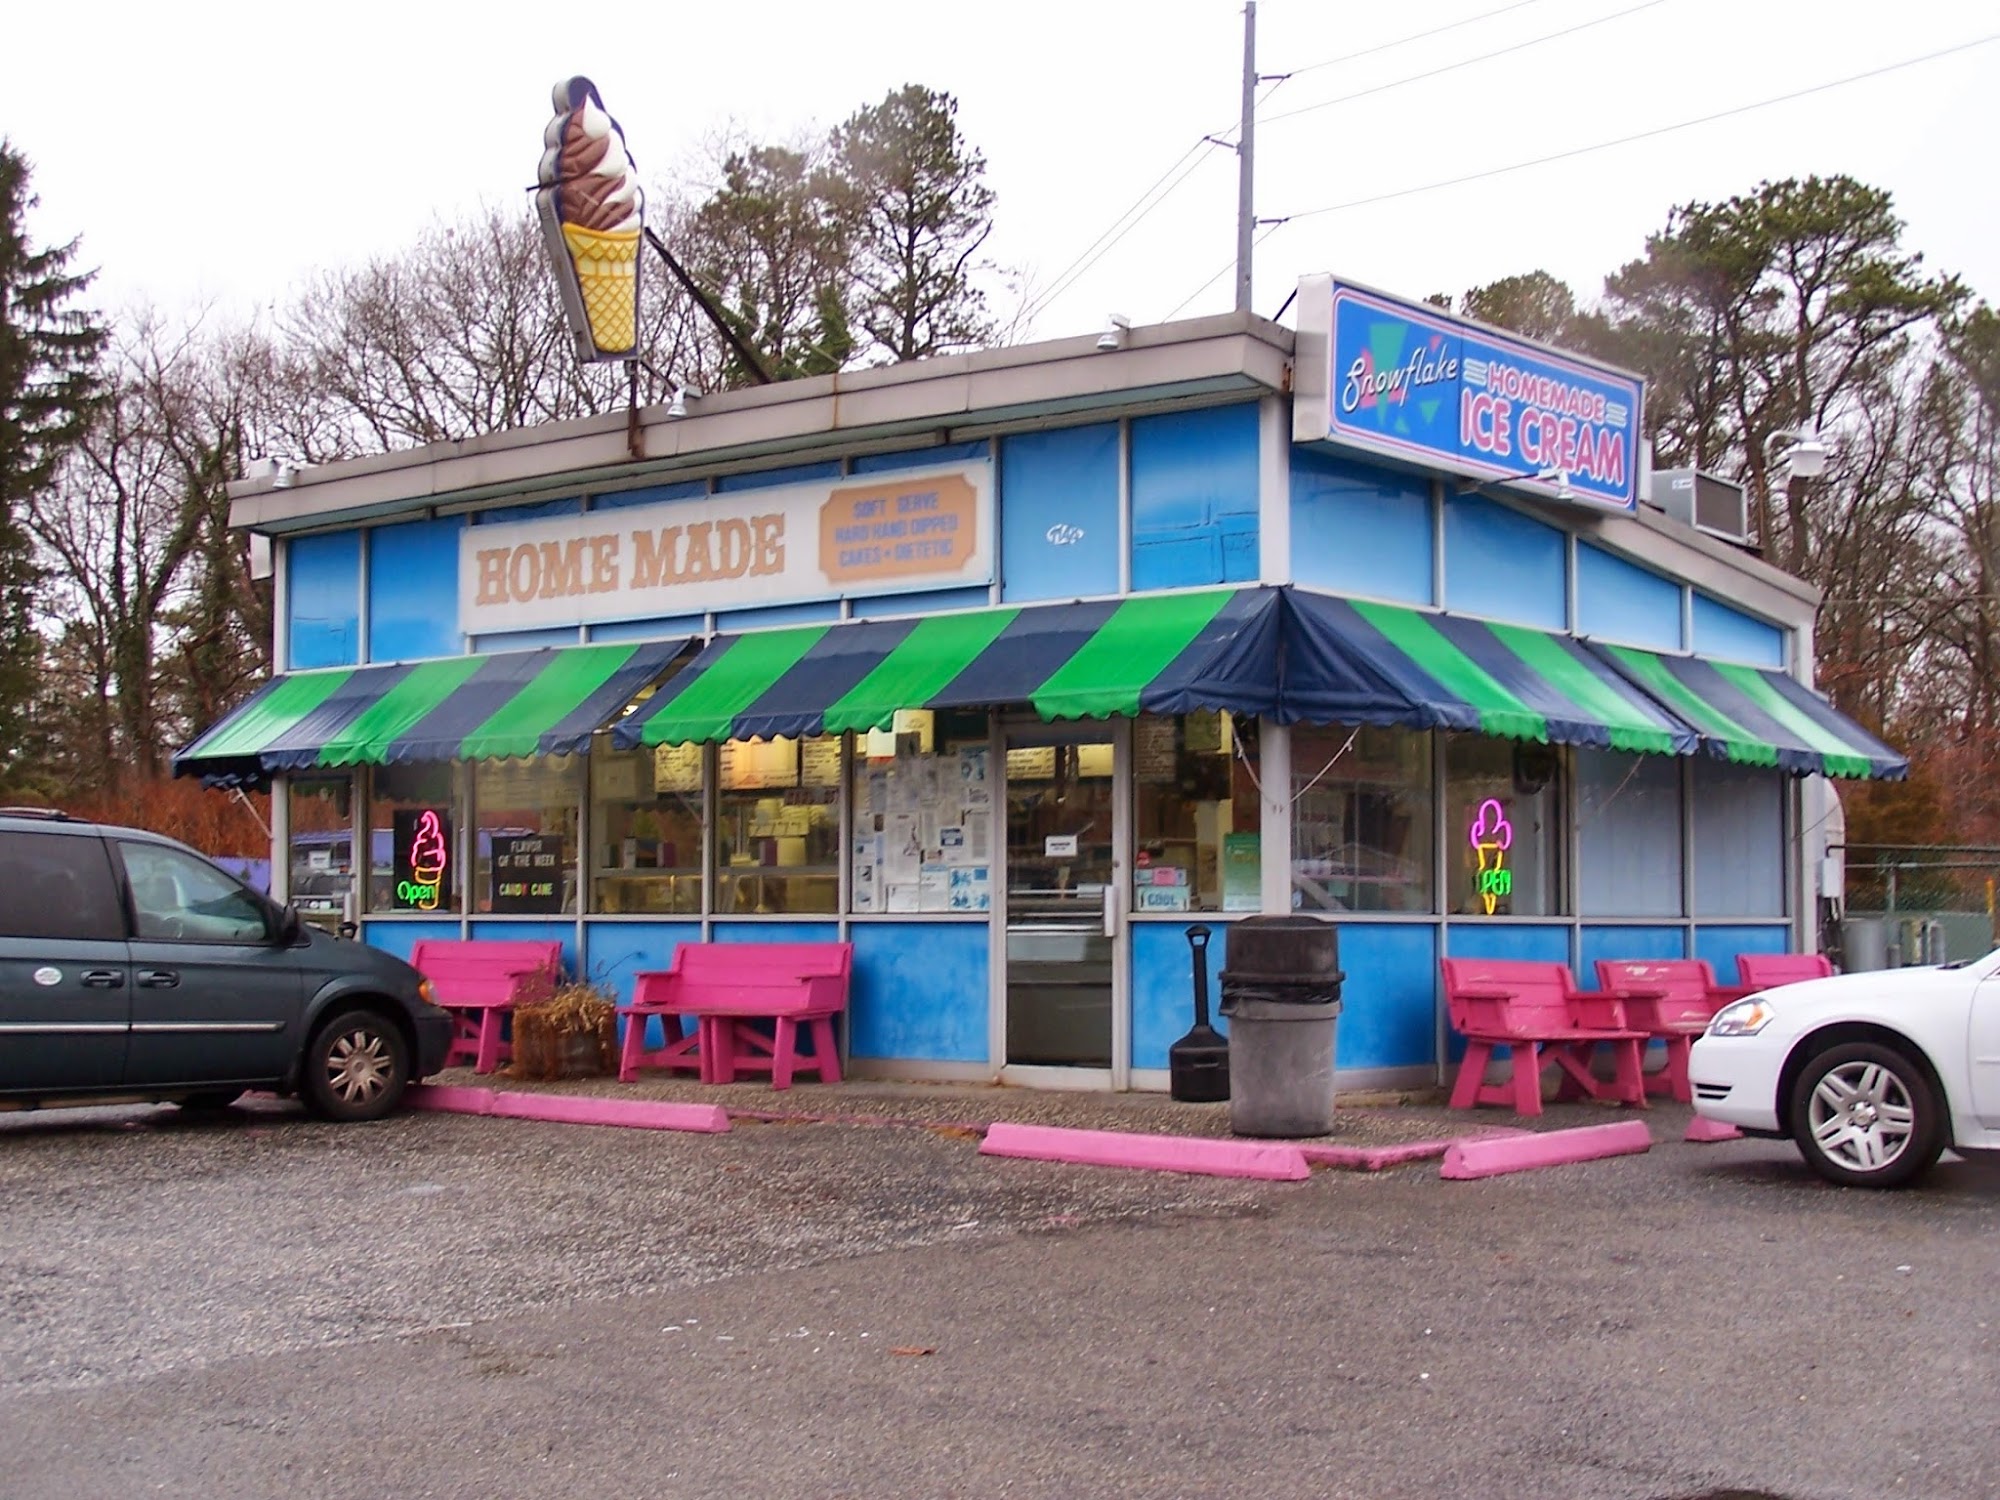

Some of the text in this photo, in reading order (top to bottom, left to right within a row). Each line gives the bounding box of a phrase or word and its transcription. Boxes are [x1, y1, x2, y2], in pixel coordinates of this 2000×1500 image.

[1342, 343, 1458, 413] Snowflake
[1487, 361, 1607, 424] HOMEMADE
[1461, 388, 1625, 486] ICE CREAM
[854, 492, 939, 519] SOFT SERVE
[911, 513, 959, 535] DIPPED
[475, 512, 786, 606] HOME MADE
[511, 840, 543, 853] FLAVOR
[514, 854, 531, 867] THE
[534, 854, 556, 867] WEEK
[397, 880, 436, 905] Open
[499, 882, 554, 897] CANDY CANE
